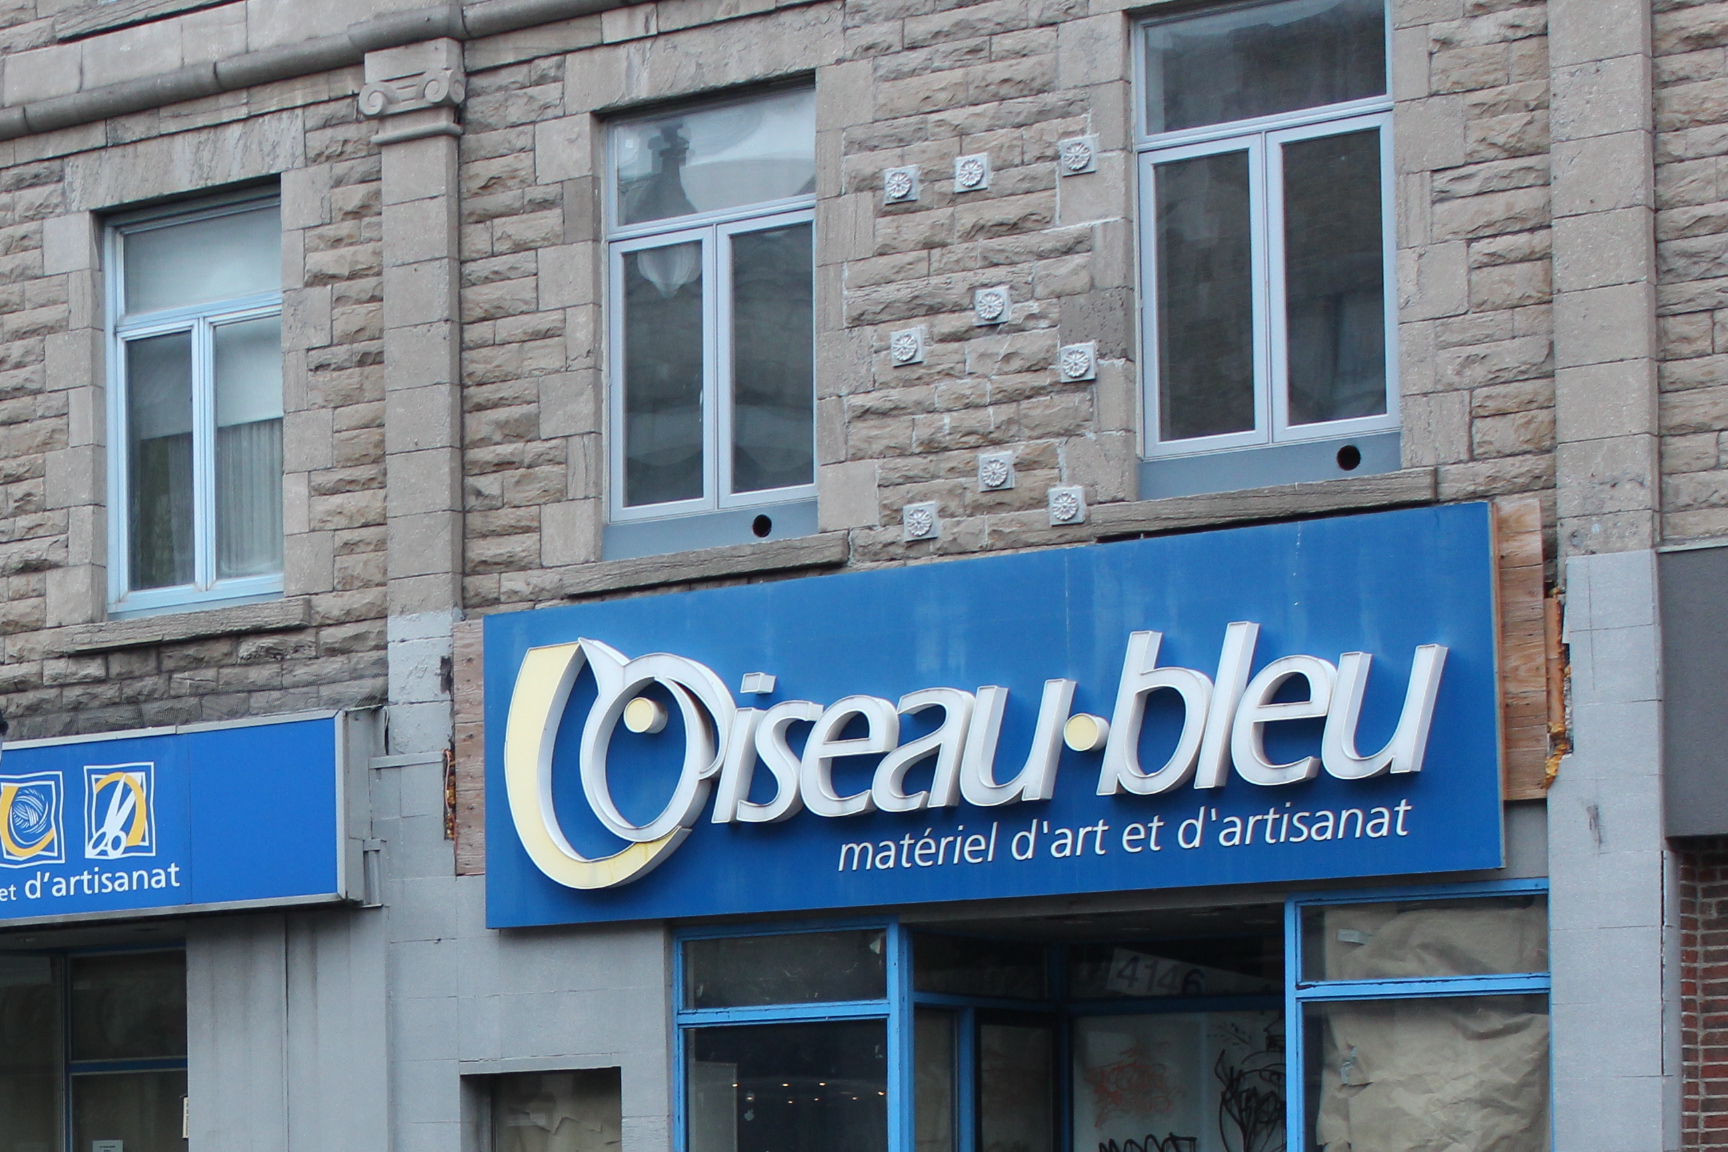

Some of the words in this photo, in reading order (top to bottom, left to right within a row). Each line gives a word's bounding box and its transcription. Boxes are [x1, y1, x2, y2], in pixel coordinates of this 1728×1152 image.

[837, 821, 998, 872] matériel
[1011, 818, 1109, 861] d'art
[1121, 814, 1164, 853] et
[1177, 798, 1412, 849] d'artisanat
